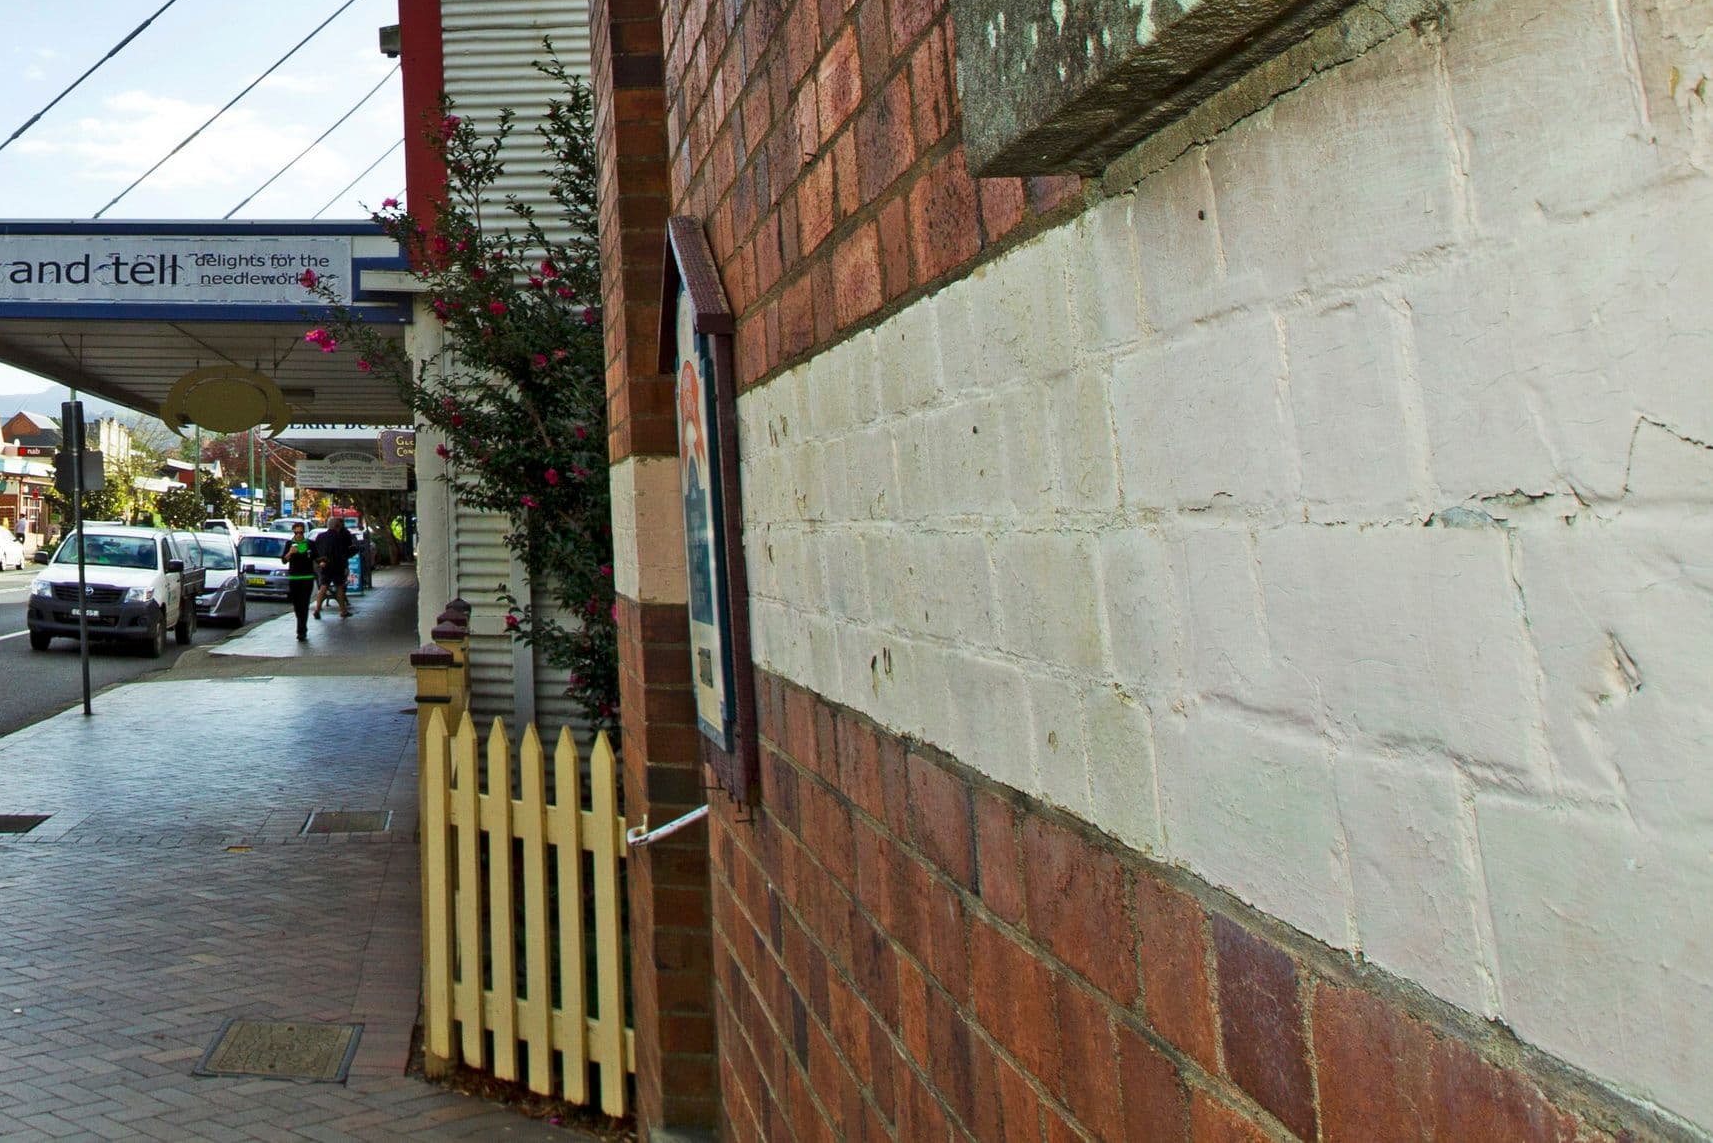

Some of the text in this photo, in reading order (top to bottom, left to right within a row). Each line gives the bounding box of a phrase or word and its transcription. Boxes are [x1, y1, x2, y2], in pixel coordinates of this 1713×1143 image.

[8, 253, 90, 285] and
[111, 253, 178, 286] tell
[194, 254, 330, 270] delights for the
